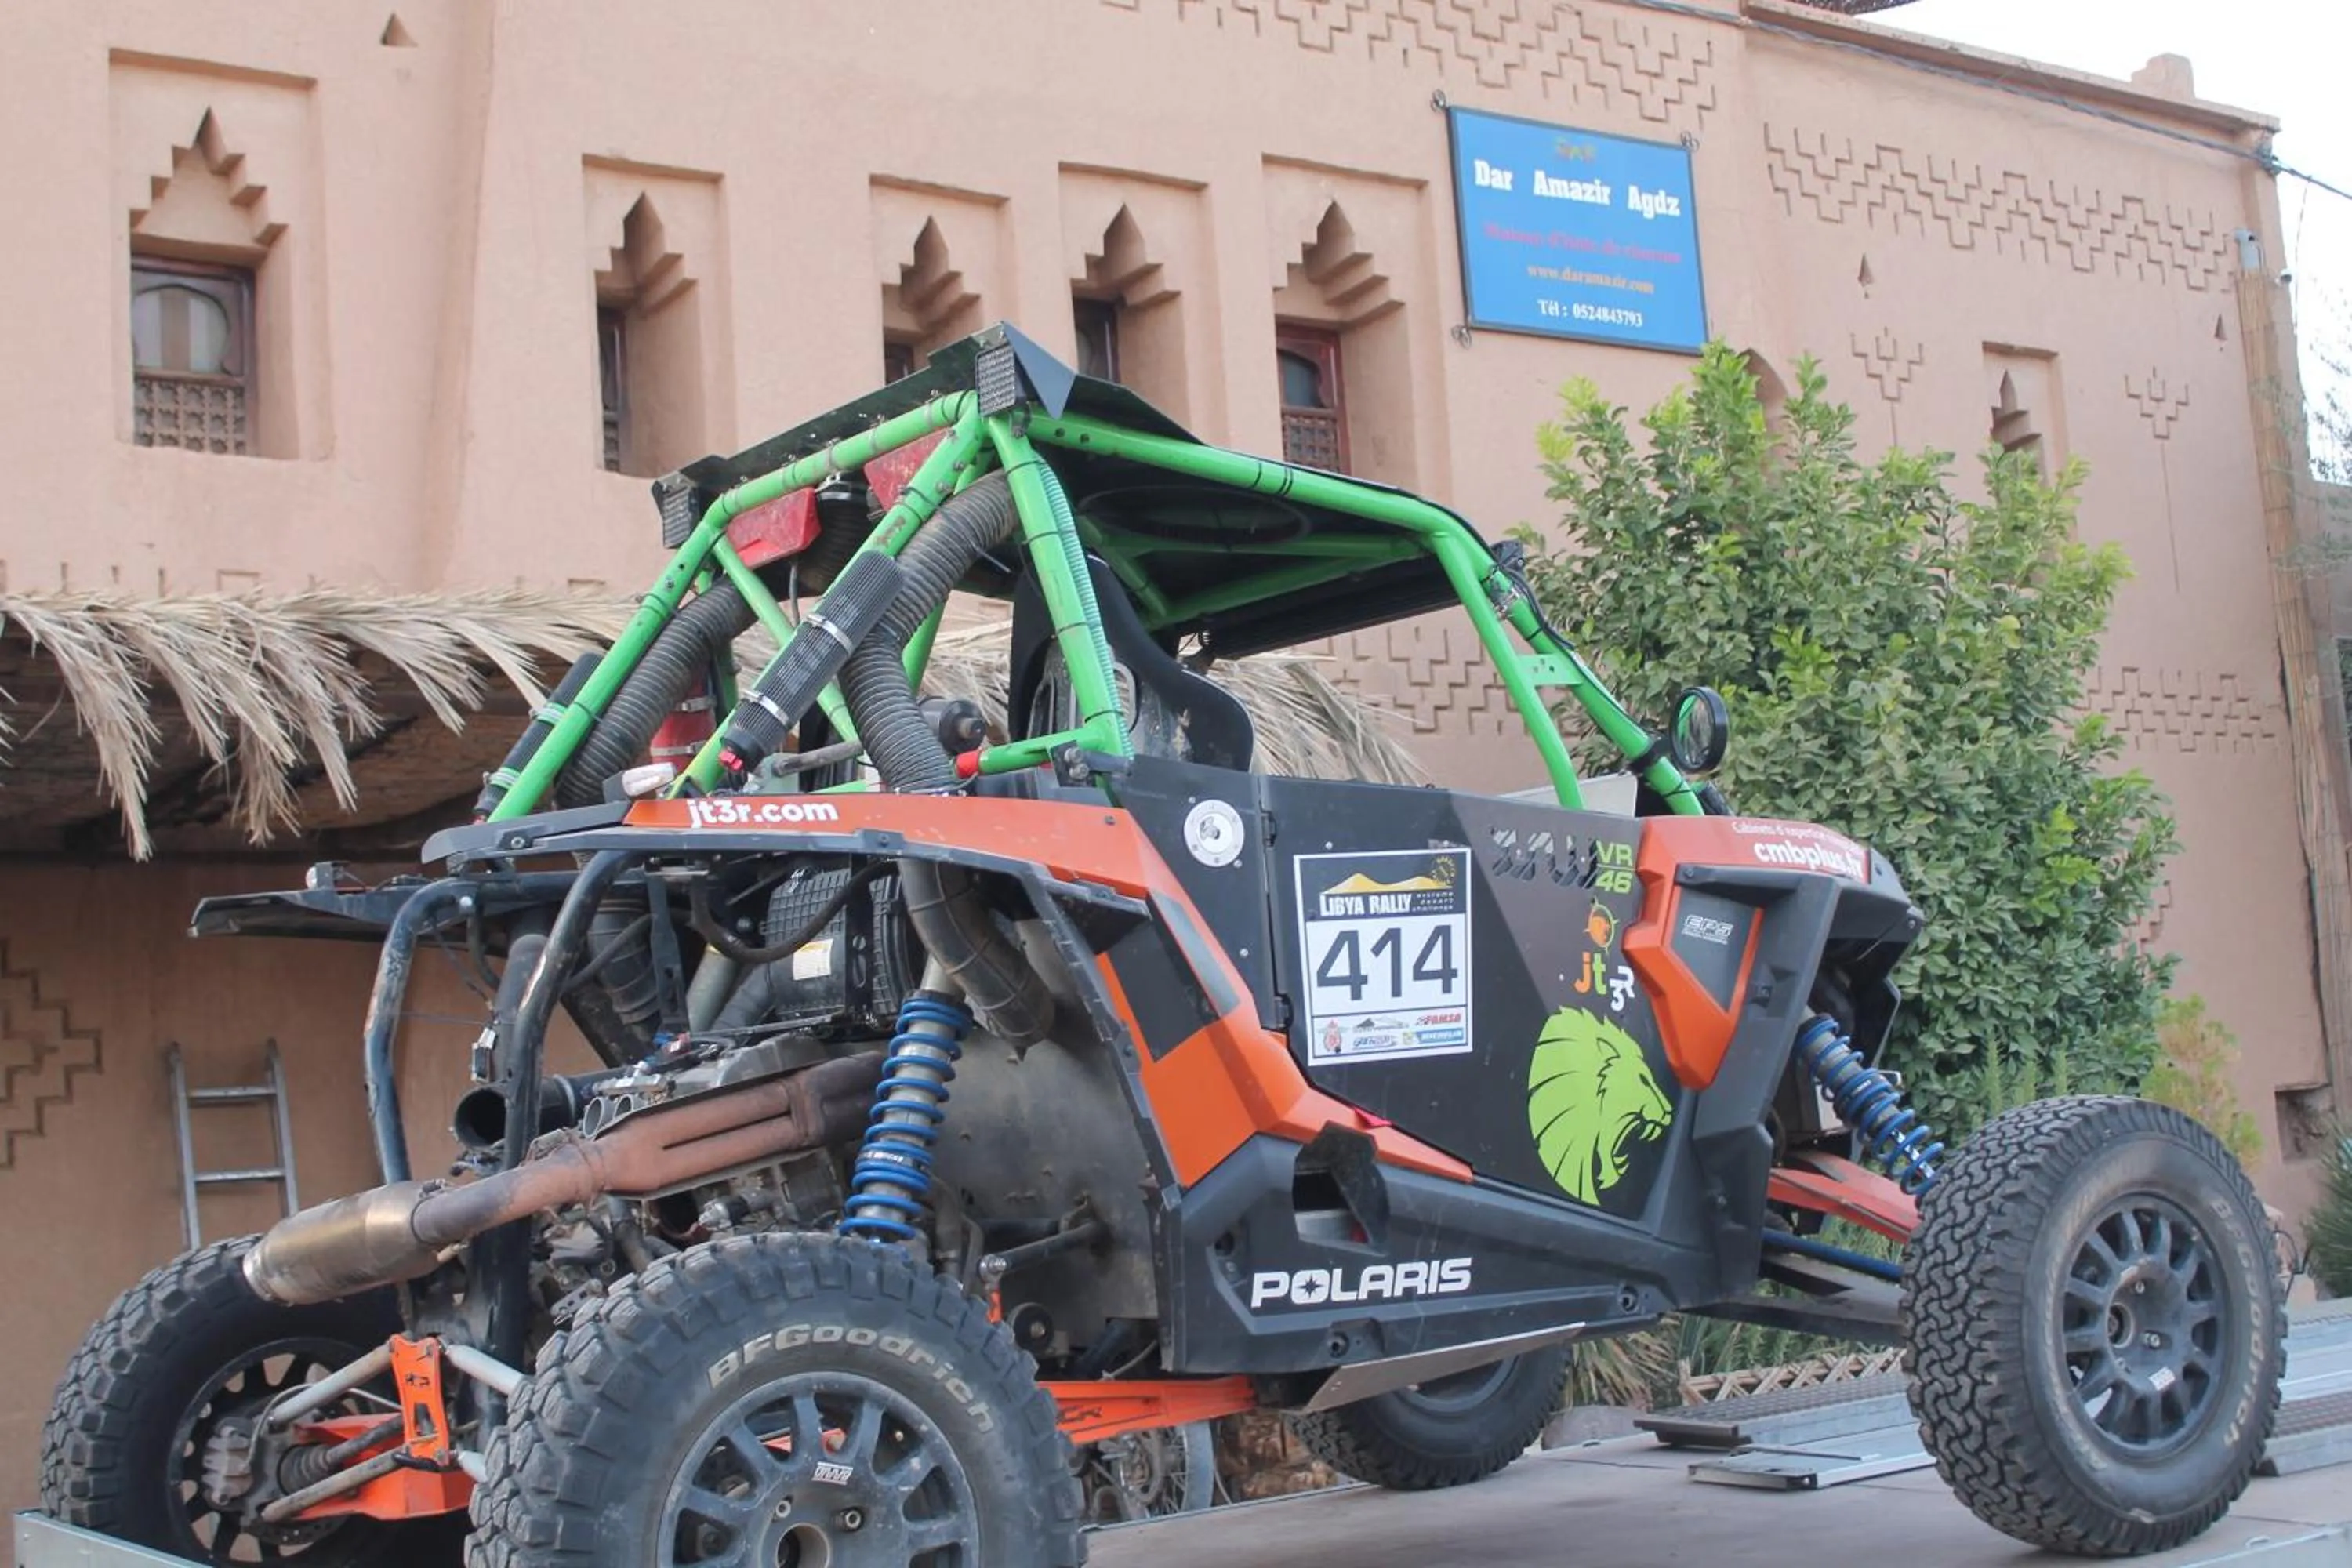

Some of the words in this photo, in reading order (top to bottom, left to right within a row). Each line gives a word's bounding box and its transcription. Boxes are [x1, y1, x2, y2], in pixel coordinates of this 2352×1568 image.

[1474, 159, 1513, 191] Dar
[1533, 169, 1611, 205] Amazir
[1628, 186, 1680, 219] Agdz
[1572, 303, 1643, 327] 0524843793
[686, 799, 839, 829] jt3r.com
[1595, 840, 1633, 866] VR
[1595, 870, 1634, 894] 46
[1319, 894, 1366, 917] LIBYA
[1369, 892, 1412, 915] RALLY
[1316, 924, 1458, 1001] 414
[1250, 1257, 1472, 1308] POLARIS
[707, 1323, 994, 1433] BFGoodrich
